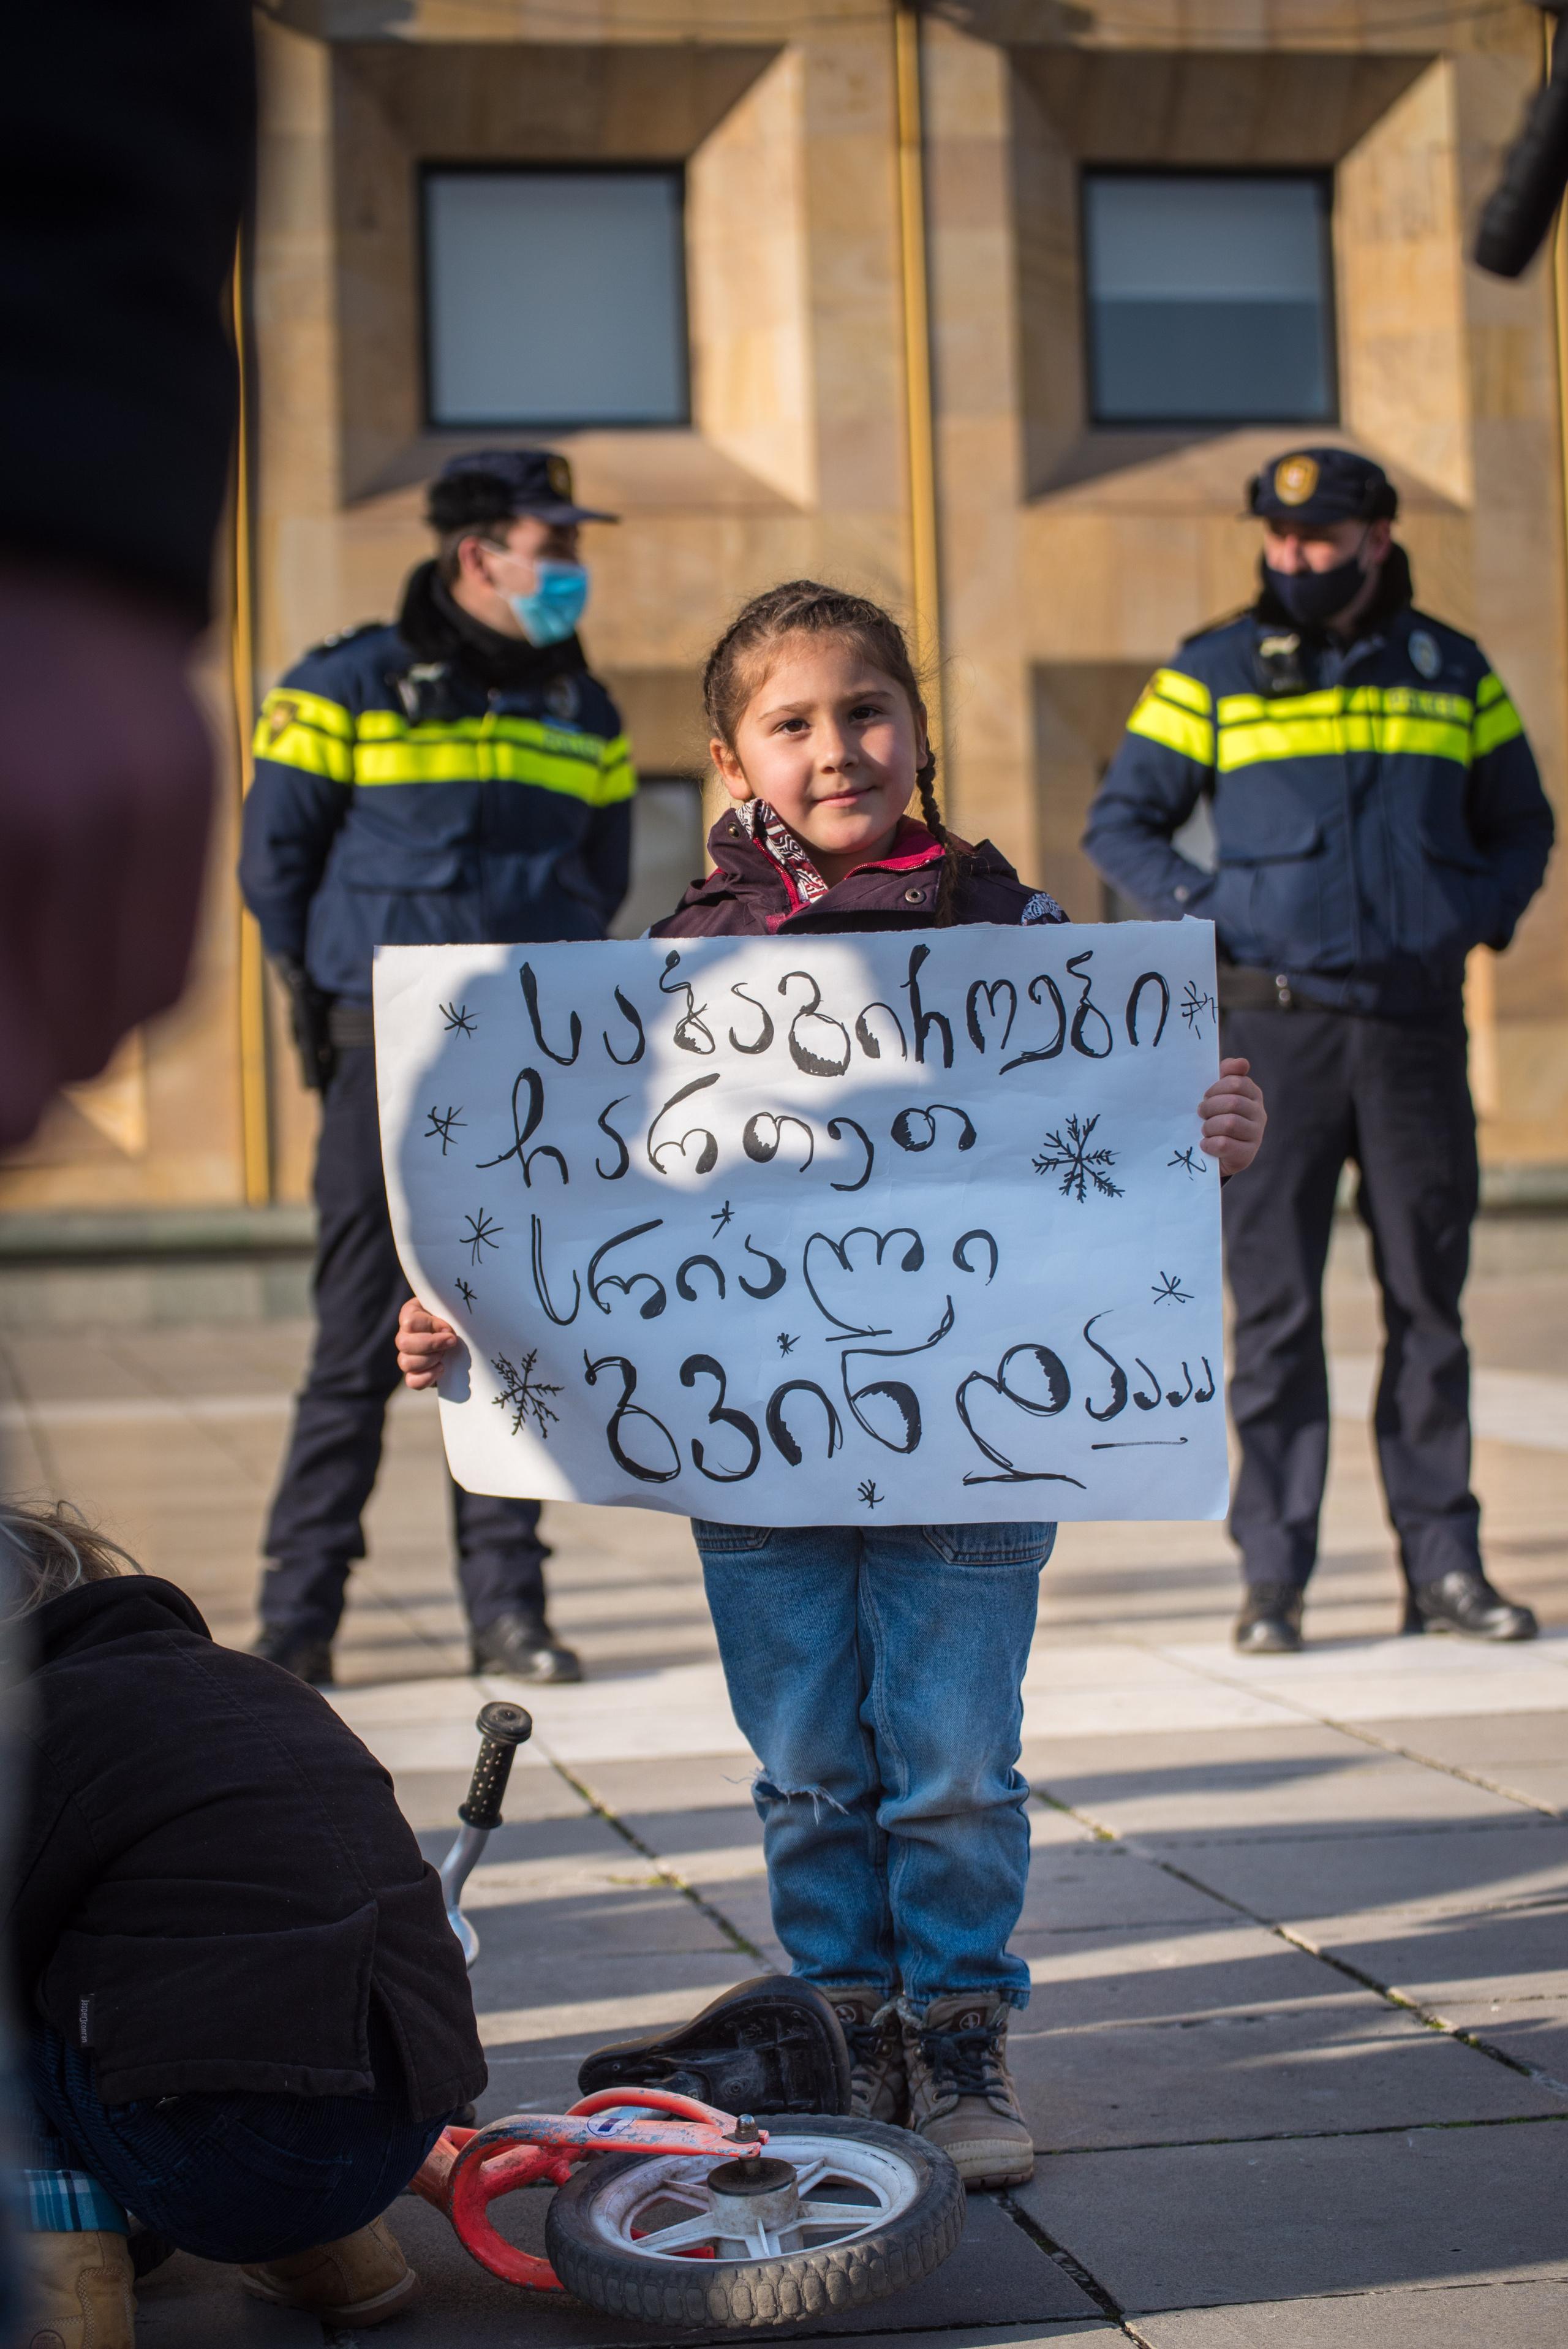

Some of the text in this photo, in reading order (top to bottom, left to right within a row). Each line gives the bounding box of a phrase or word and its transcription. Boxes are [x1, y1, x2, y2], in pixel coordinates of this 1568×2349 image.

[519, 944, 1170, 1076] საბაგიროები
[476, 1067, 977, 1192] ჩართეთ
[530, 1214, 998, 1342] სრიალი
